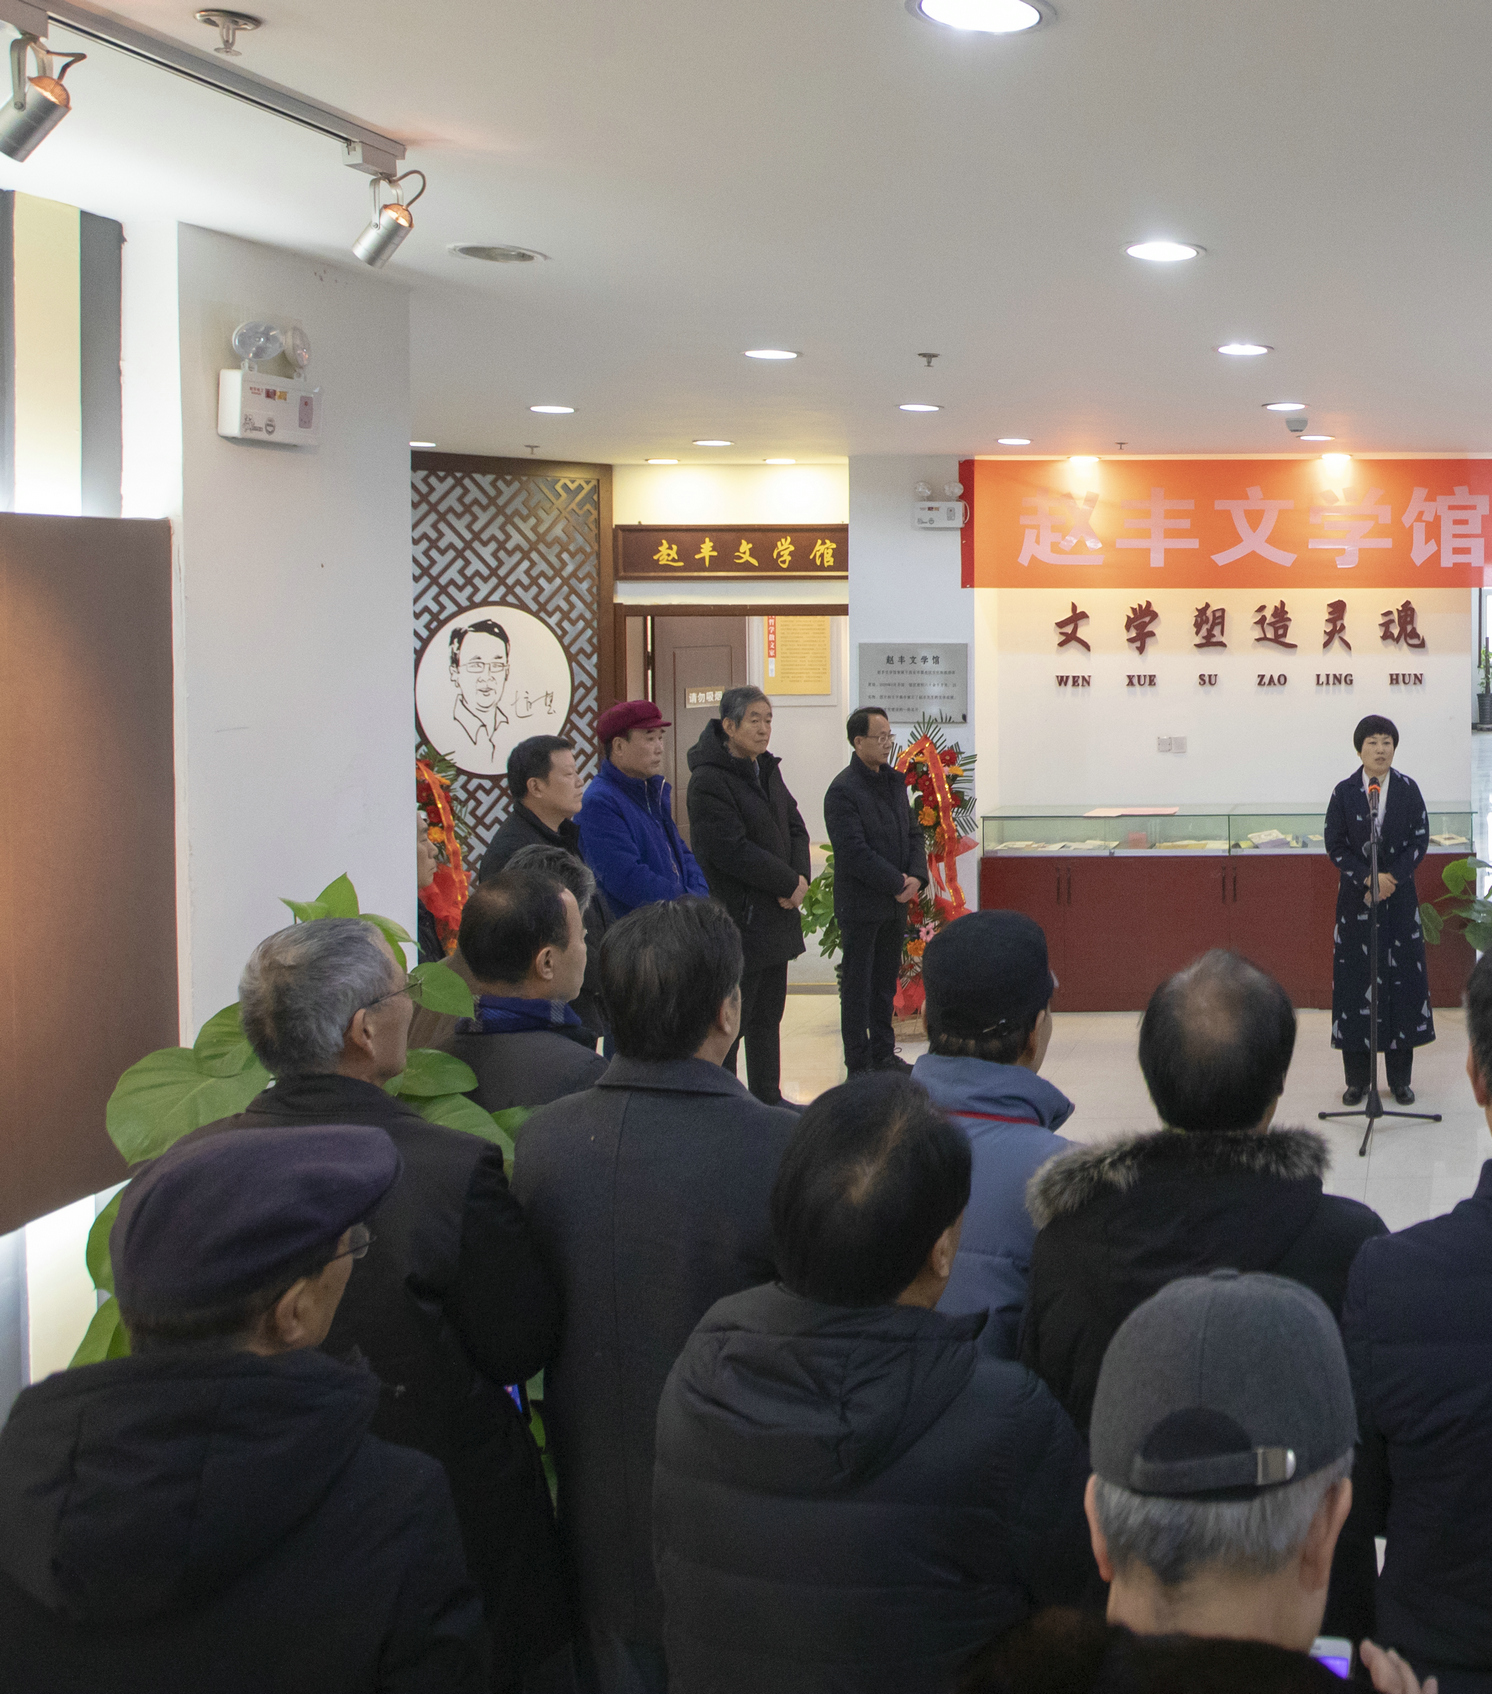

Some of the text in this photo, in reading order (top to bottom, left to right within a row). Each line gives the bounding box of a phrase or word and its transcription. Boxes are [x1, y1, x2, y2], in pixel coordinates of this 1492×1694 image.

[653, 536, 836, 568] 赵丰文学馆
[1054, 600, 1426, 654] 文学塑造灵魂
[886, 655, 940, 665] 赵丰文学馆
[1055, 673, 1424, 688] WEN XUE SU ZAO LING HUN
[689, 691, 722, 704] 请勿吸烟
